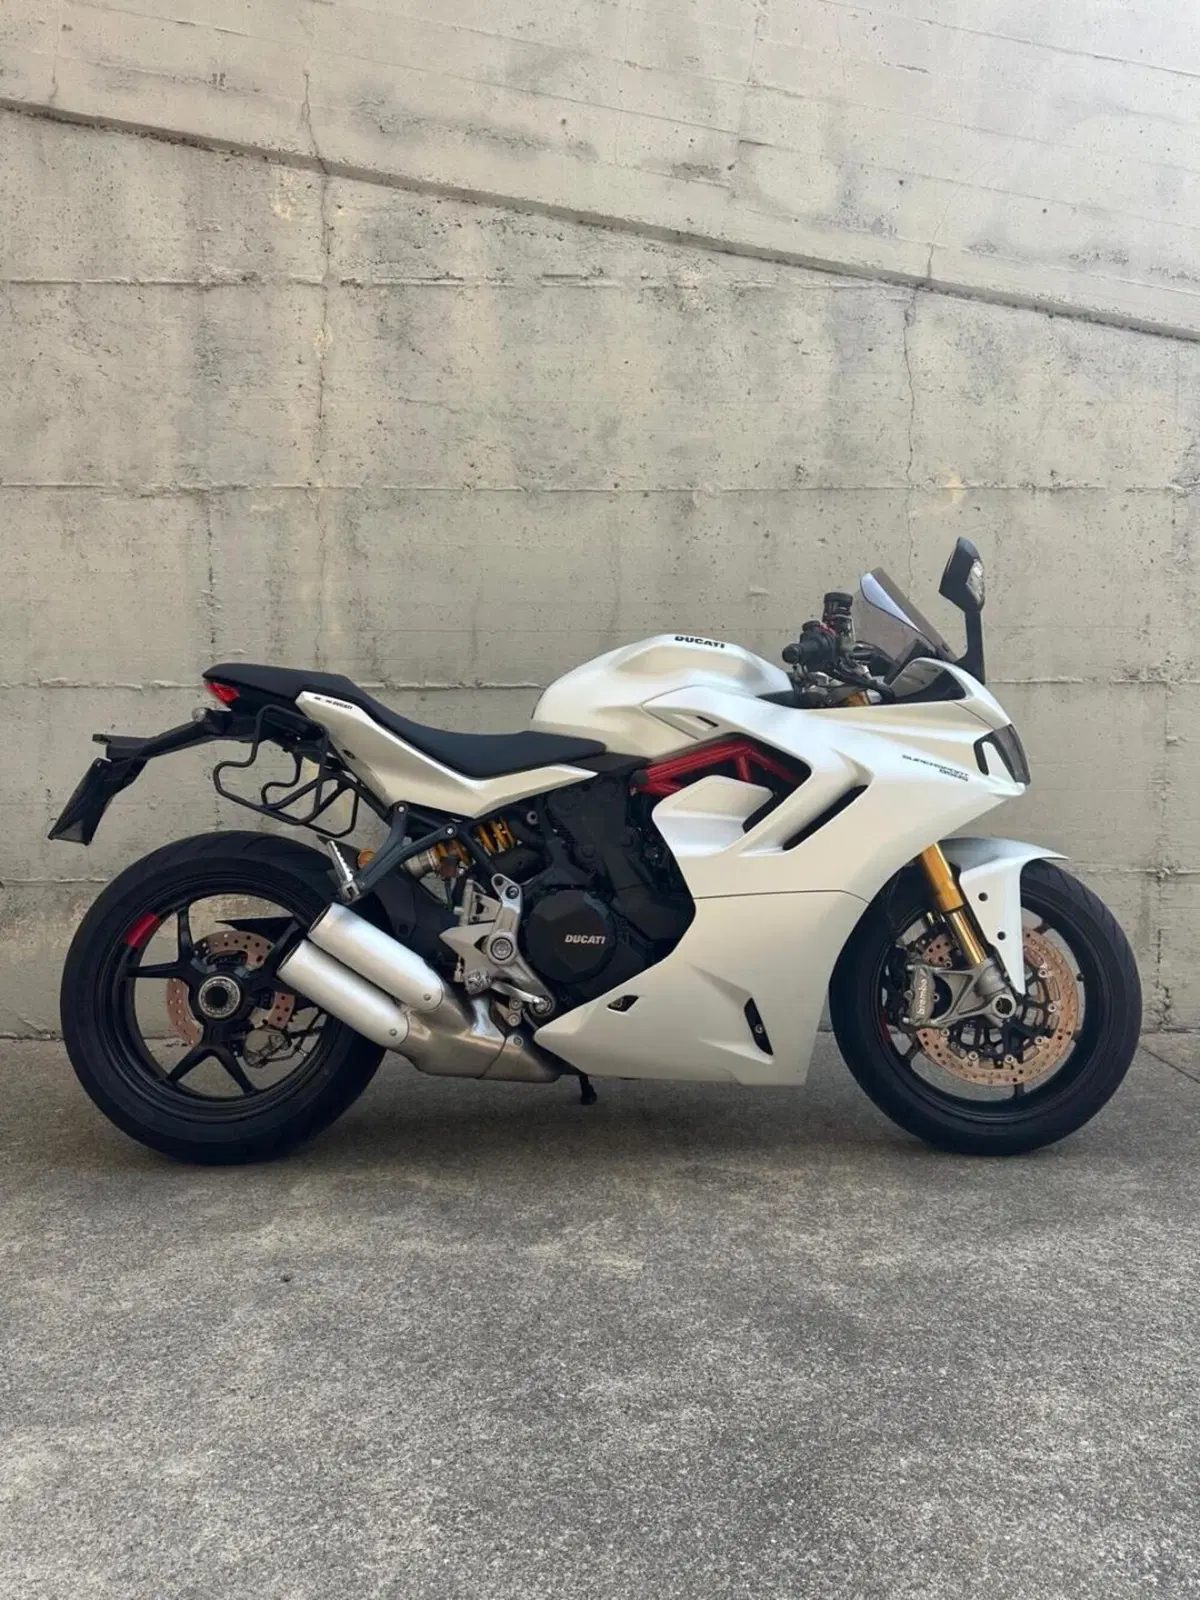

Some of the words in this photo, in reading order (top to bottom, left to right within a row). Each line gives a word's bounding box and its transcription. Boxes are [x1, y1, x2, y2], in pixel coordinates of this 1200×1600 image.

[674, 636, 725, 649] DUCATI
[564, 934, 606, 945] DUCATI
[916, 978, 928, 1015] brembo
